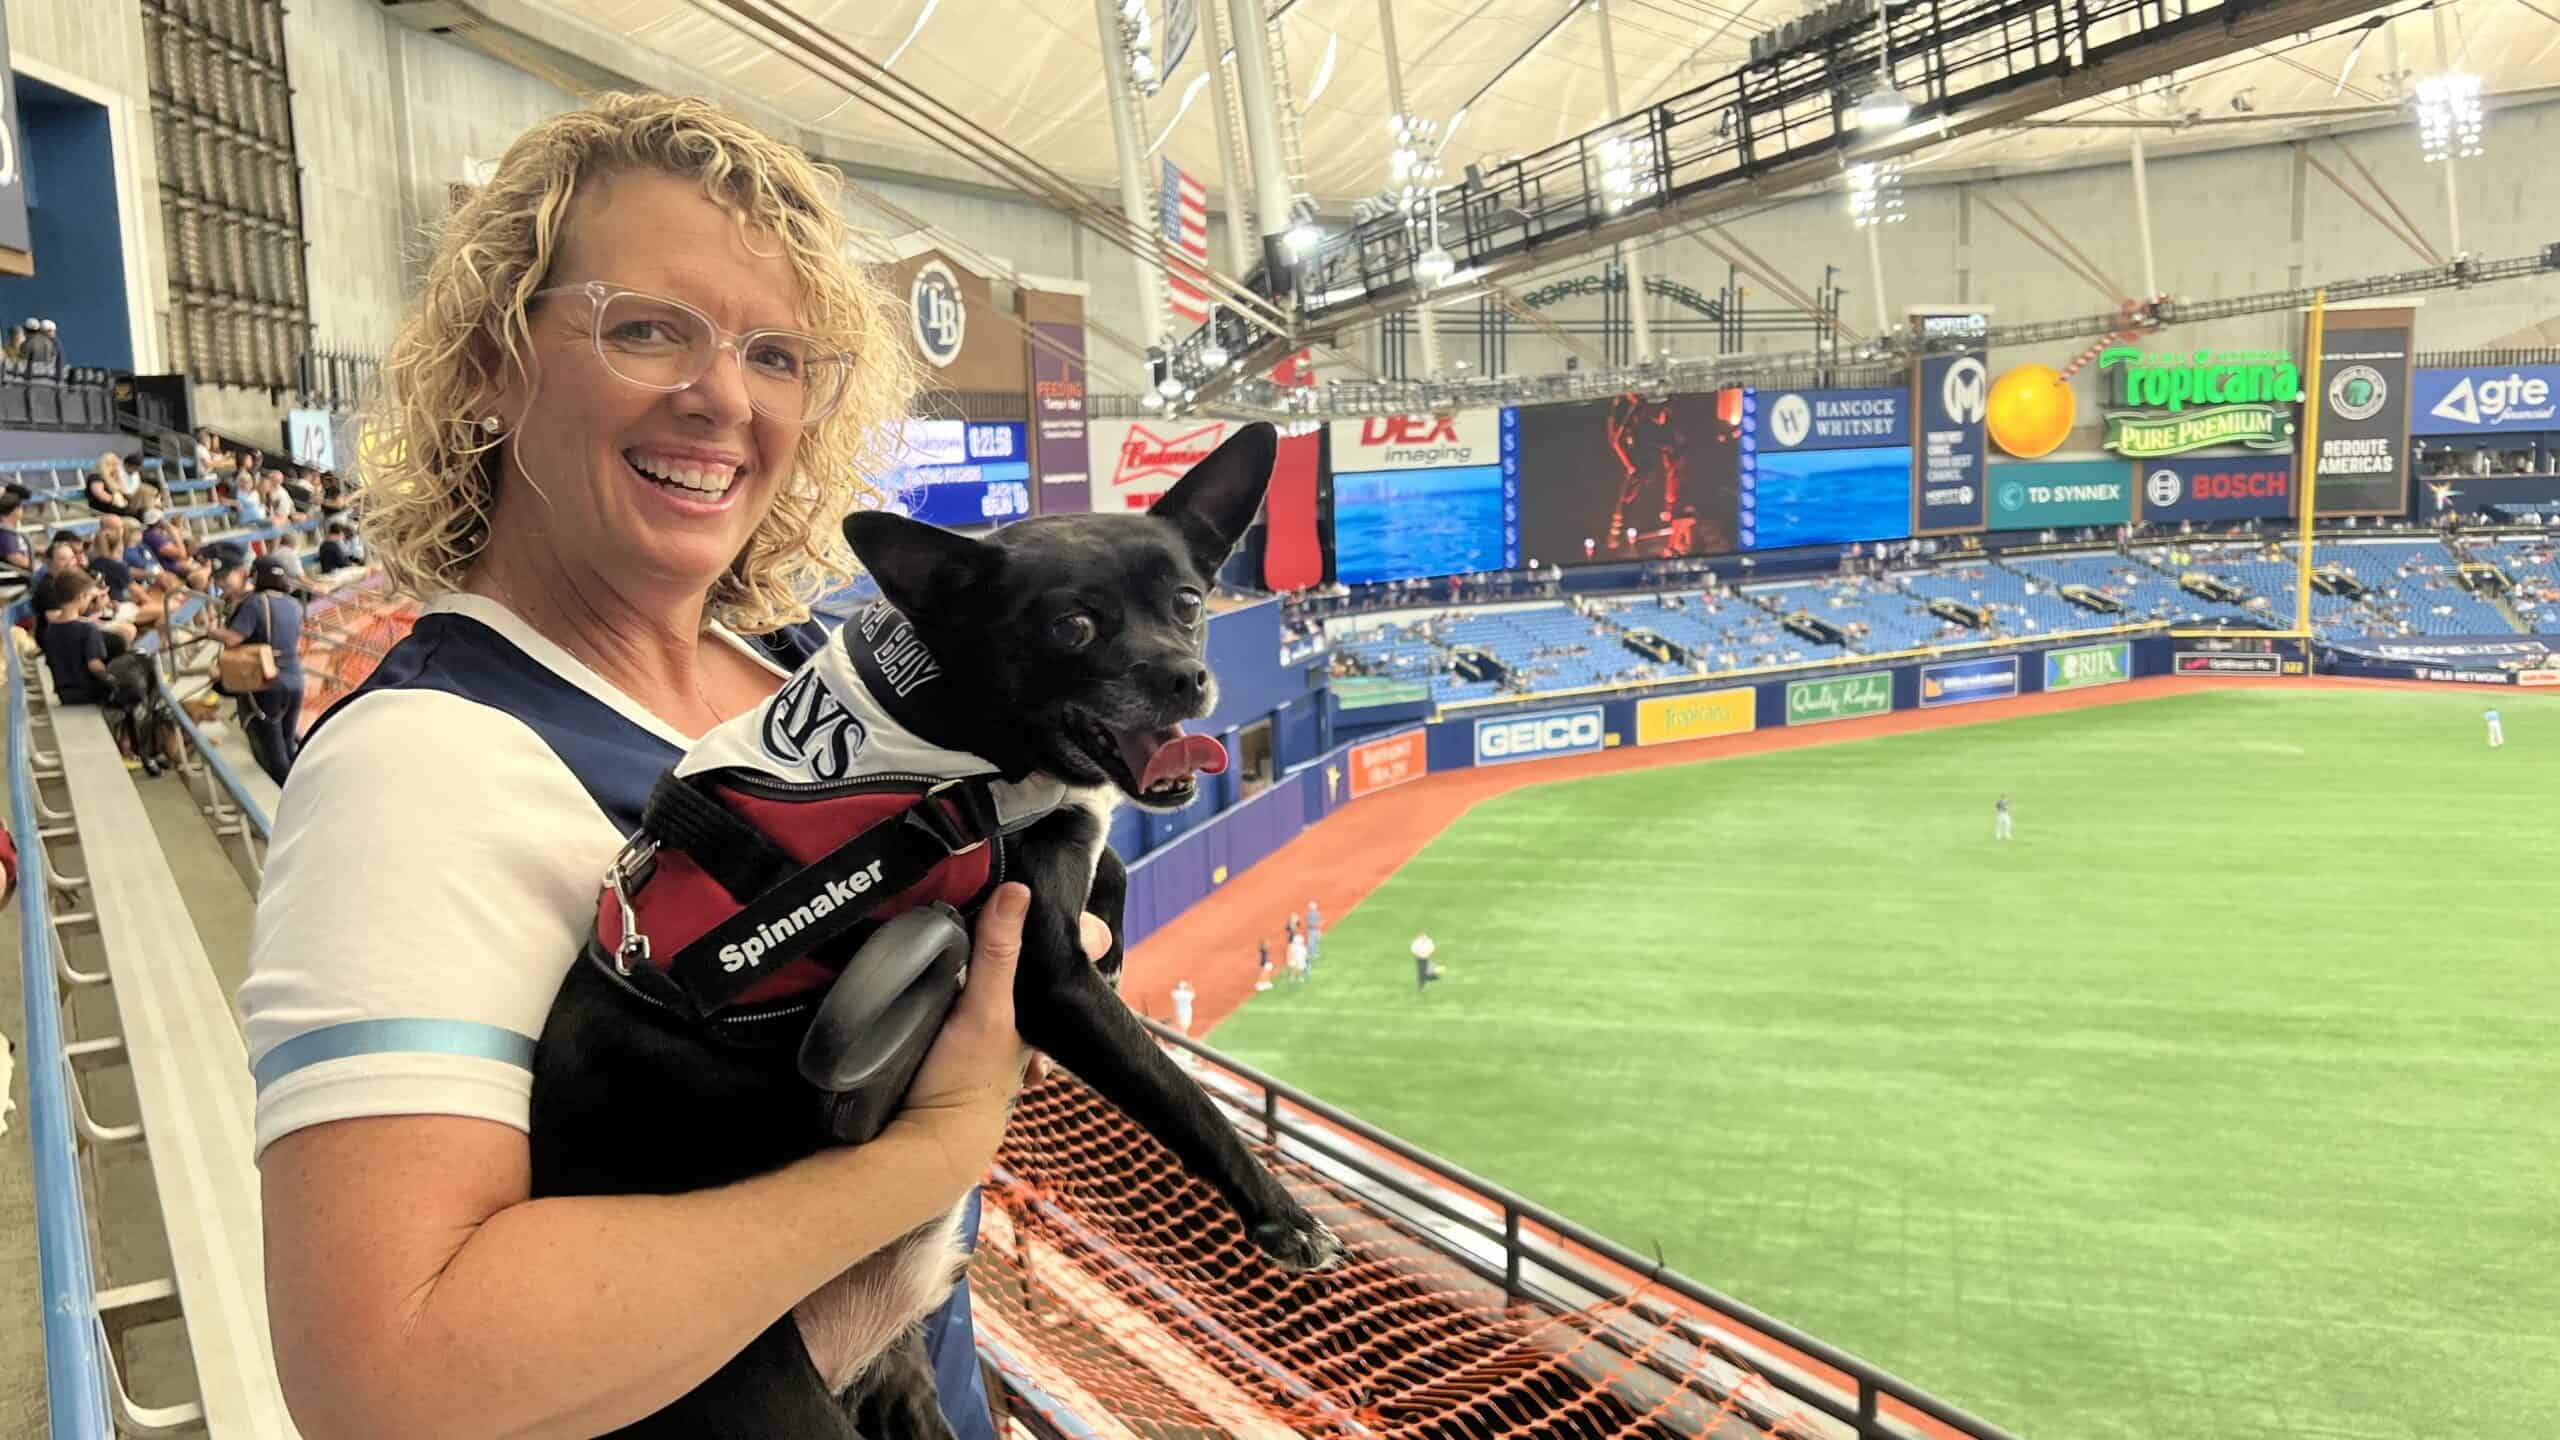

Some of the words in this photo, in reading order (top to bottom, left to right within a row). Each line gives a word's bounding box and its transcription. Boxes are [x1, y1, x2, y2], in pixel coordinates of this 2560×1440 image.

[920, 280, 958, 346] TB
[2098, 345, 2298, 413] Tropicana
[2477, 372, 2550, 415] gte
[1815, 398, 1896, 418] HANCOCK
[1360, 414, 1460, 447] DEX
[1815, 418, 1896, 437] WHITNEY
[2119, 423, 2177, 450] PURE
[2177, 411, 2274, 446] PREMIUM
[1384, 443, 1473, 465] imaging
[2323, 438, 2389, 457] REROUTE
[2317, 456, 2393, 475] AMERICAS
[2028, 486, 2050, 503] TD
[2053, 484, 2120, 502] SYNNEX
[2191, 471, 2288, 499] BOSCH
[1480, 714, 1600, 757] GEICO
[718, 858, 884, 974] Spinnaker
